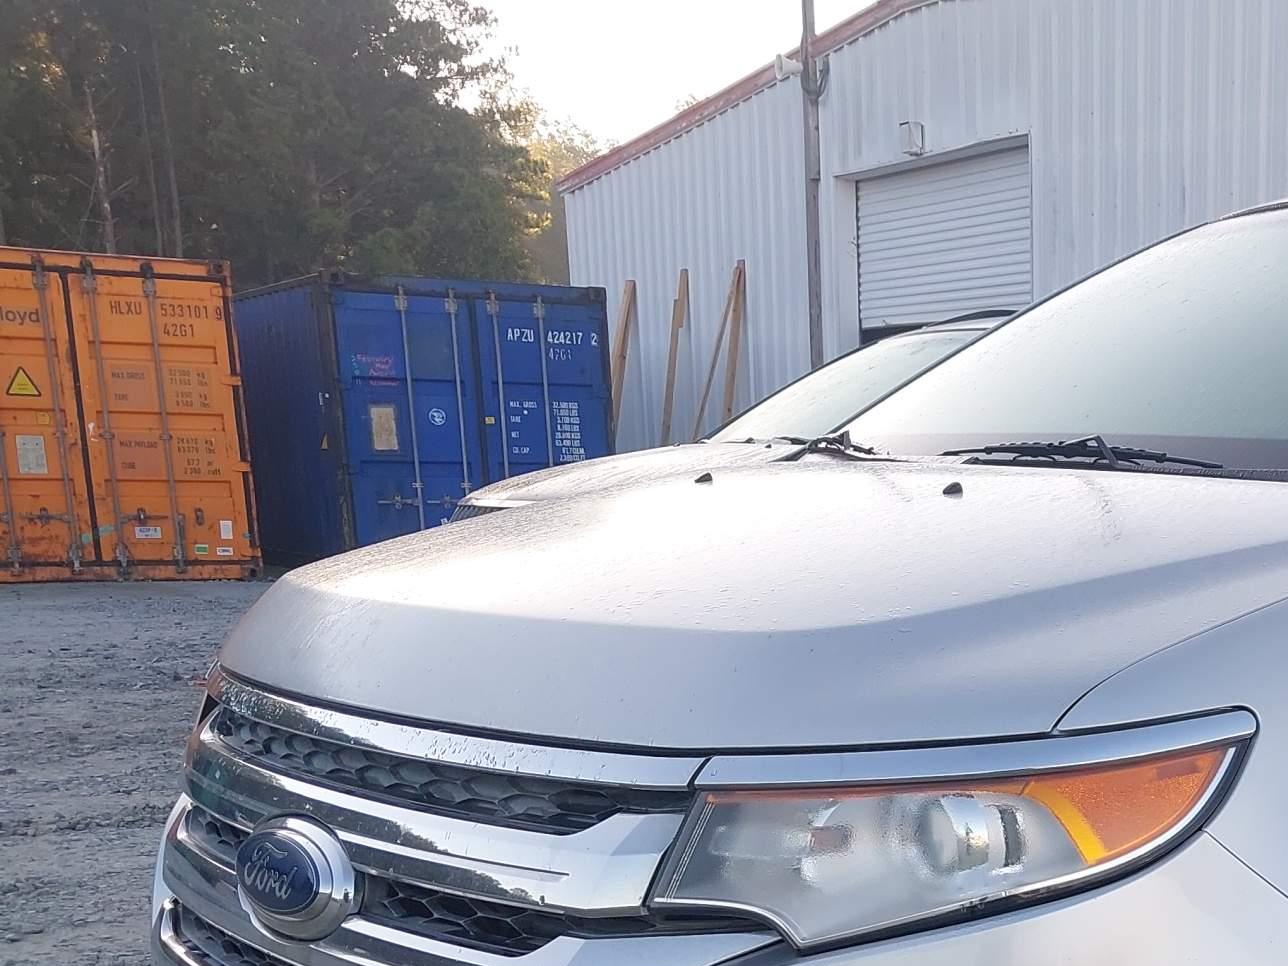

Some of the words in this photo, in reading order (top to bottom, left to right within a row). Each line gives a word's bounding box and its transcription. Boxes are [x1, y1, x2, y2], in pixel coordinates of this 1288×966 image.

[110, 301, 142, 315] HLXU
[161, 304, 209, 319] 533101
[215, 307, 222, 320] 9
[163, 324, 195, 338] 42G1
[507, 328, 534, 342] APZU
[547, 331, 582, 345] 424217
[591, 333, 598, 345] 2
[244, 841, 298, 901] Ford
